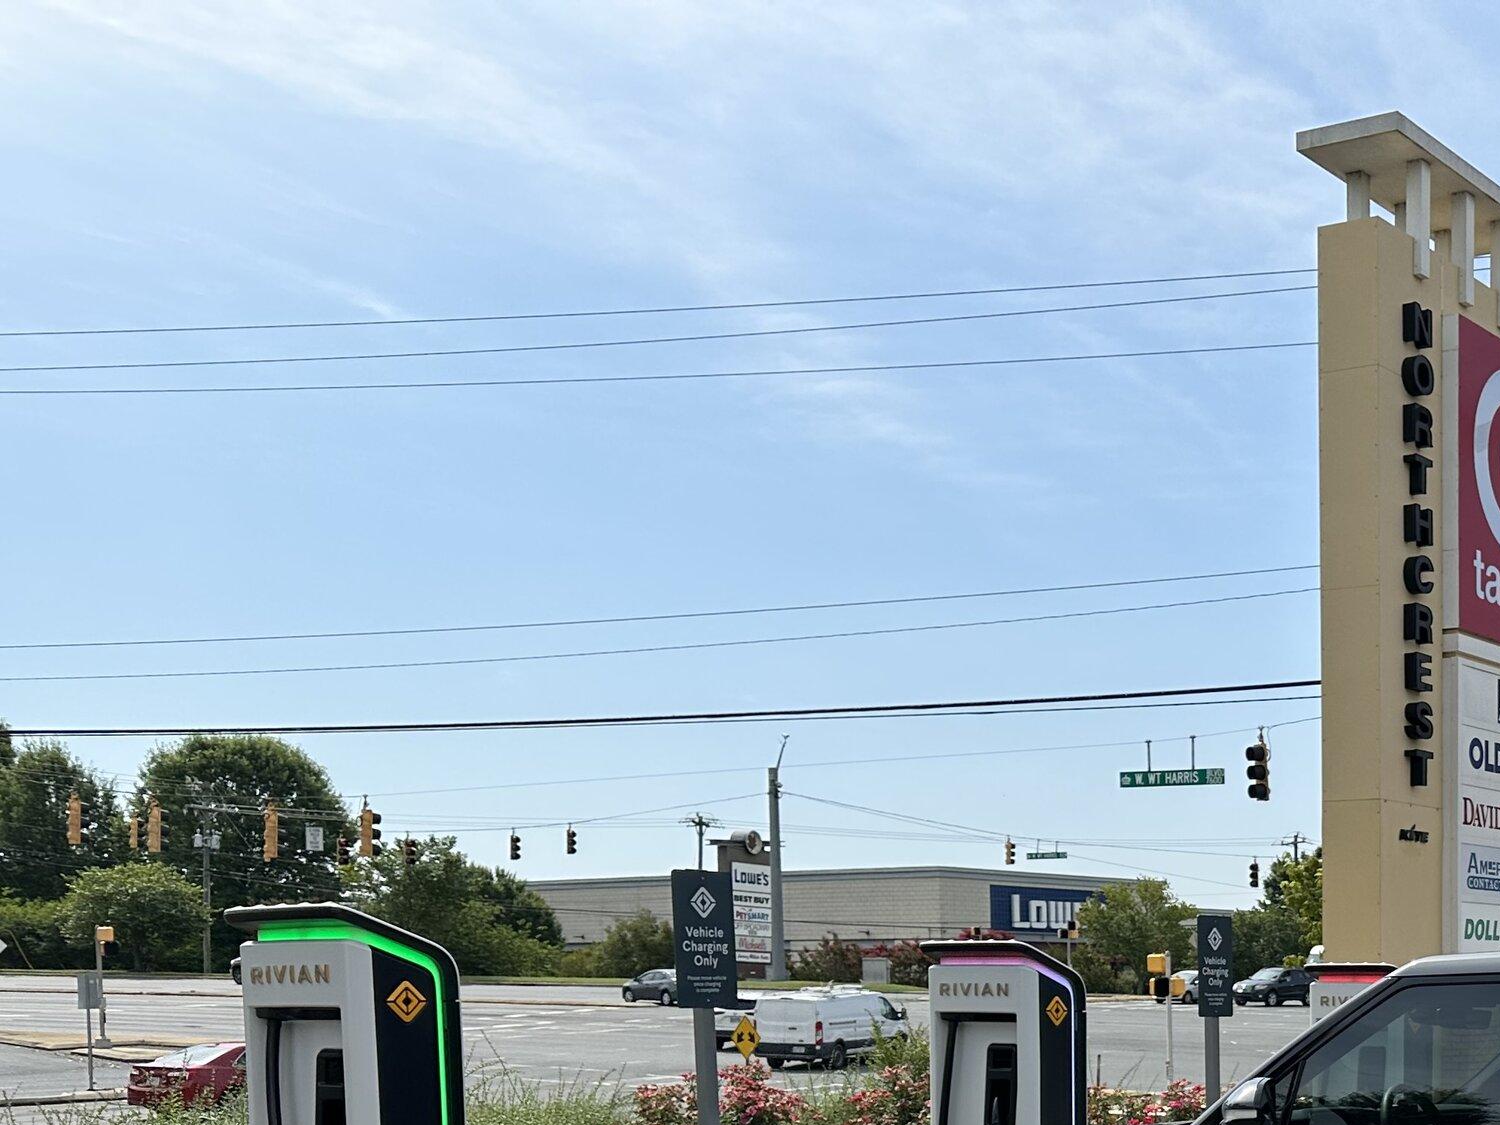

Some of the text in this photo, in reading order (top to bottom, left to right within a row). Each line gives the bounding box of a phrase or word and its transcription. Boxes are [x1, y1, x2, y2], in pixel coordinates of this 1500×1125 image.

[1402, 301, 1435, 788] NORTHCREST
[1147, 772, 1161, 784] WT
[1164, 771, 1199, 784] HARRIS
[734, 868, 769, 886] LOWE'S
[734, 894, 770, 905] BEST BUY
[685, 926, 724, 938] Vehicle
[682, 940, 729, 955] Charging
[694, 955, 719, 970] Only
[1204, 957, 1227, 965] Vehicle
[250, 964, 331, 985] RIVIAN
[1202, 967, 1229, 977] Charging
[939, 982, 1009, 997] RIVIAN
[1320, 995, 1352, 1007] RIV
